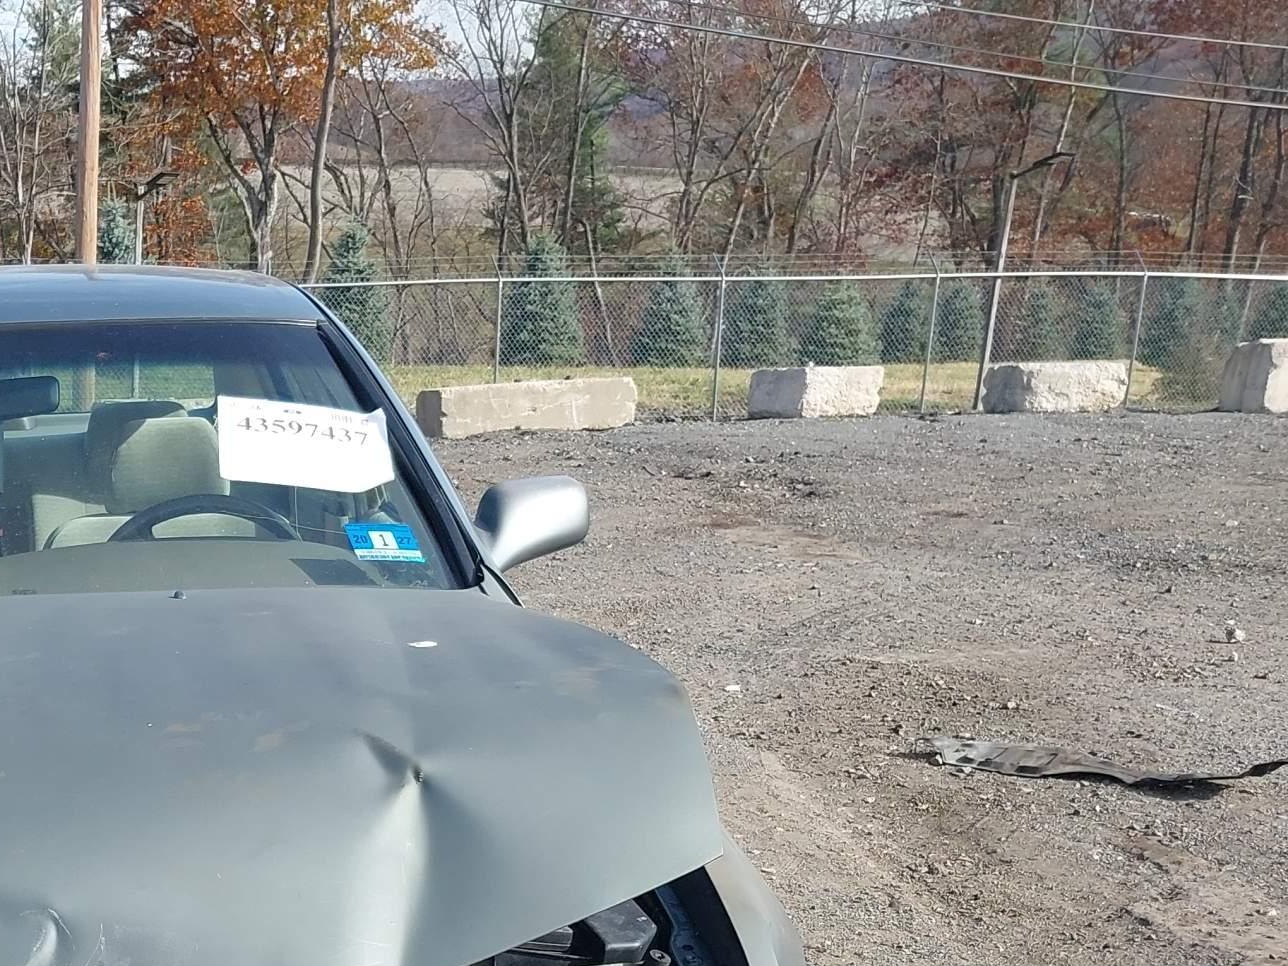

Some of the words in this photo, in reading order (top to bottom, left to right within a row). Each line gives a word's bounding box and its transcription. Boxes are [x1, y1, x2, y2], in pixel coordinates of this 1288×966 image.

[237, 416, 368, 446] 43597437
[353, 534, 368, 544] 20
[379, 534, 389, 546] 1
[398, 536, 411, 545] 27
